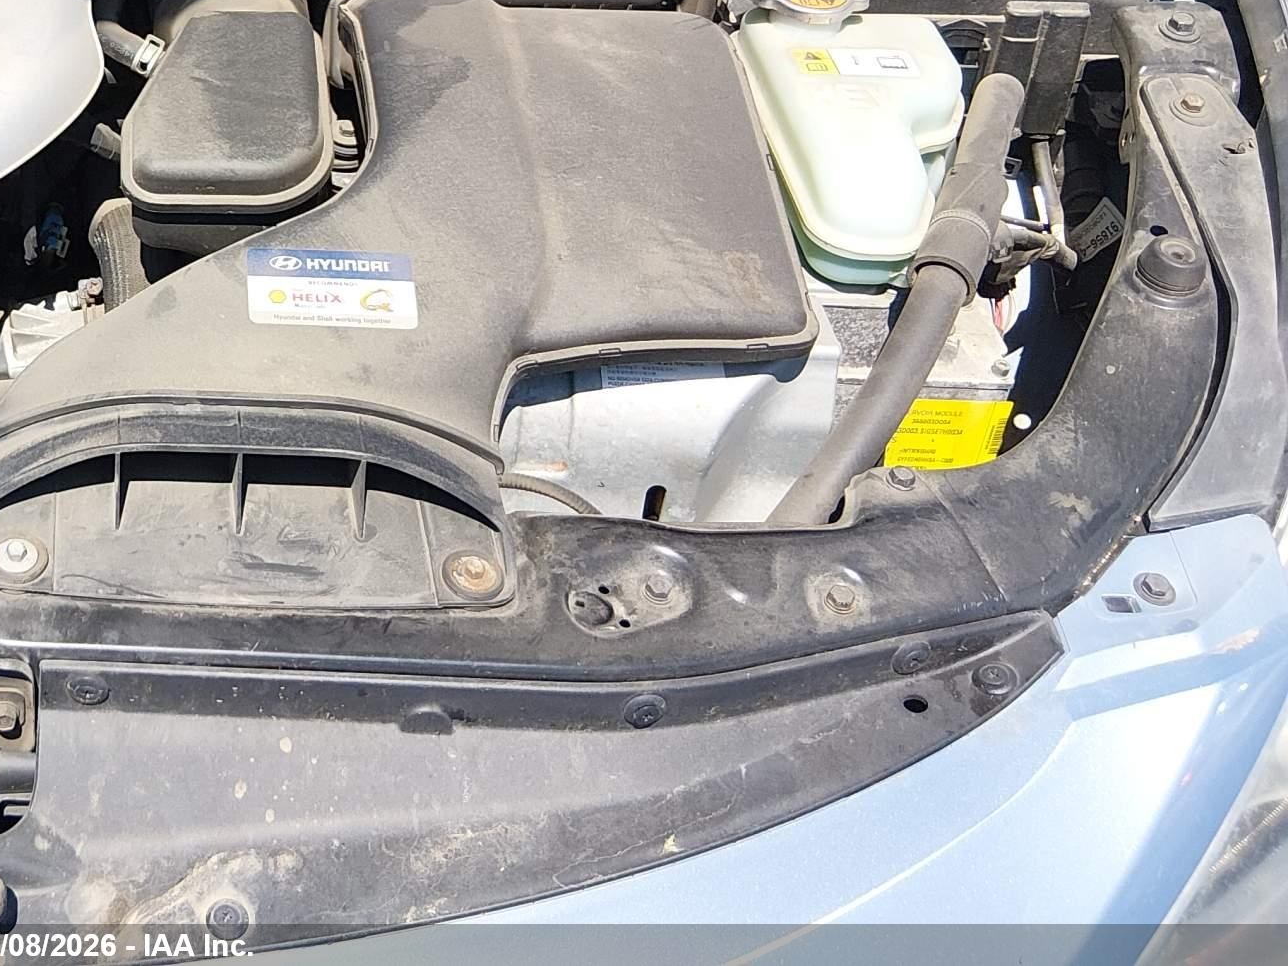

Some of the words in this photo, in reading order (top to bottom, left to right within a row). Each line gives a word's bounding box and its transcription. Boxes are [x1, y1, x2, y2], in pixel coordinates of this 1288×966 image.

[307, 258, 391, 273] HYUNDAI
[292, 290, 342, 304] HELIX
[273, 313, 301, 323] Hyundai
[303, 314, 315, 322] and
[316, 314, 333, 323] Shell
[335, 315, 362, 325] working
[363, 316, 391, 326] together
